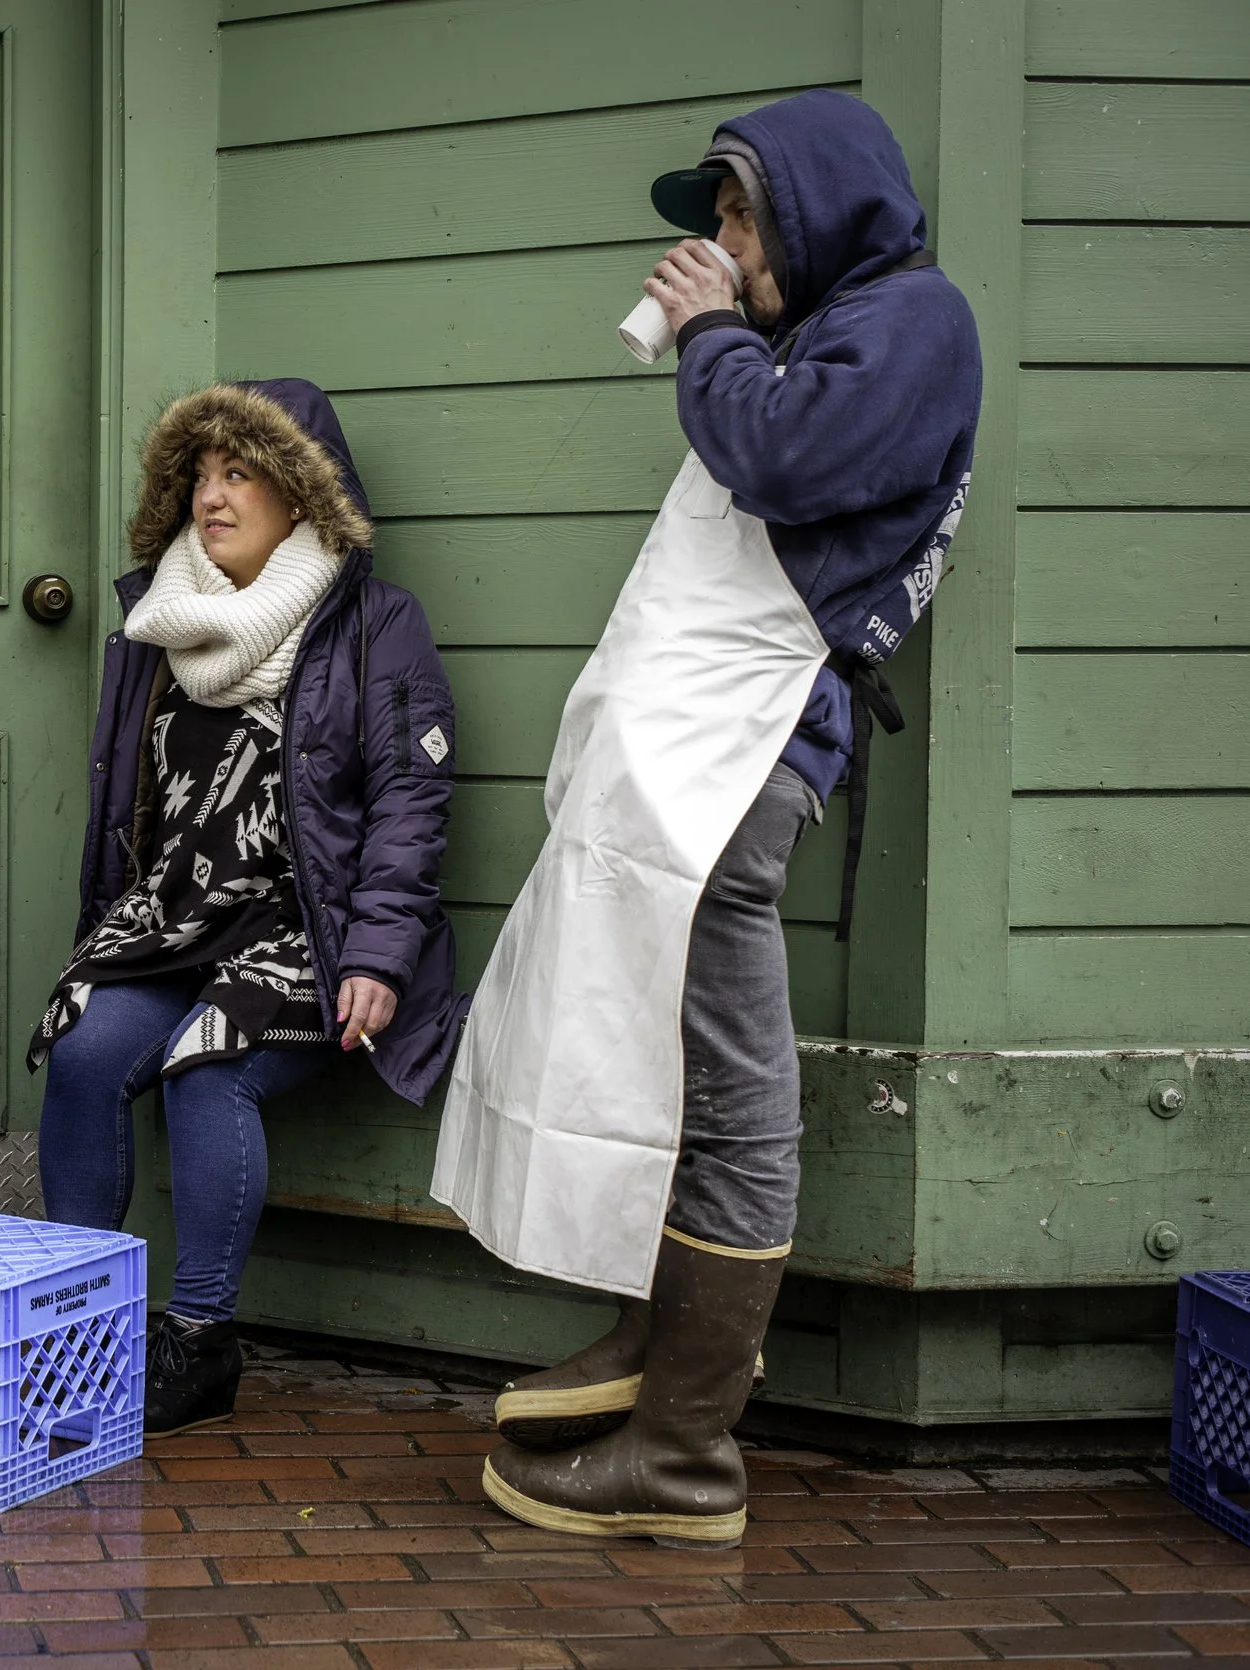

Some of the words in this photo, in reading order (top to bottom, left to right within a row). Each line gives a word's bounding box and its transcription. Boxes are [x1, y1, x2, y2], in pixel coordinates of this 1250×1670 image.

[866, 615, 900, 648] PIKE
[55, 1279, 88, 1303] BROTHERS
[89, 1273, 111, 1292] SMITH
[30, 1291, 54, 1311] FARMS
[55, 1305, 63, 1316] OF
[63, 1296, 87, 1314] PROPERTY
